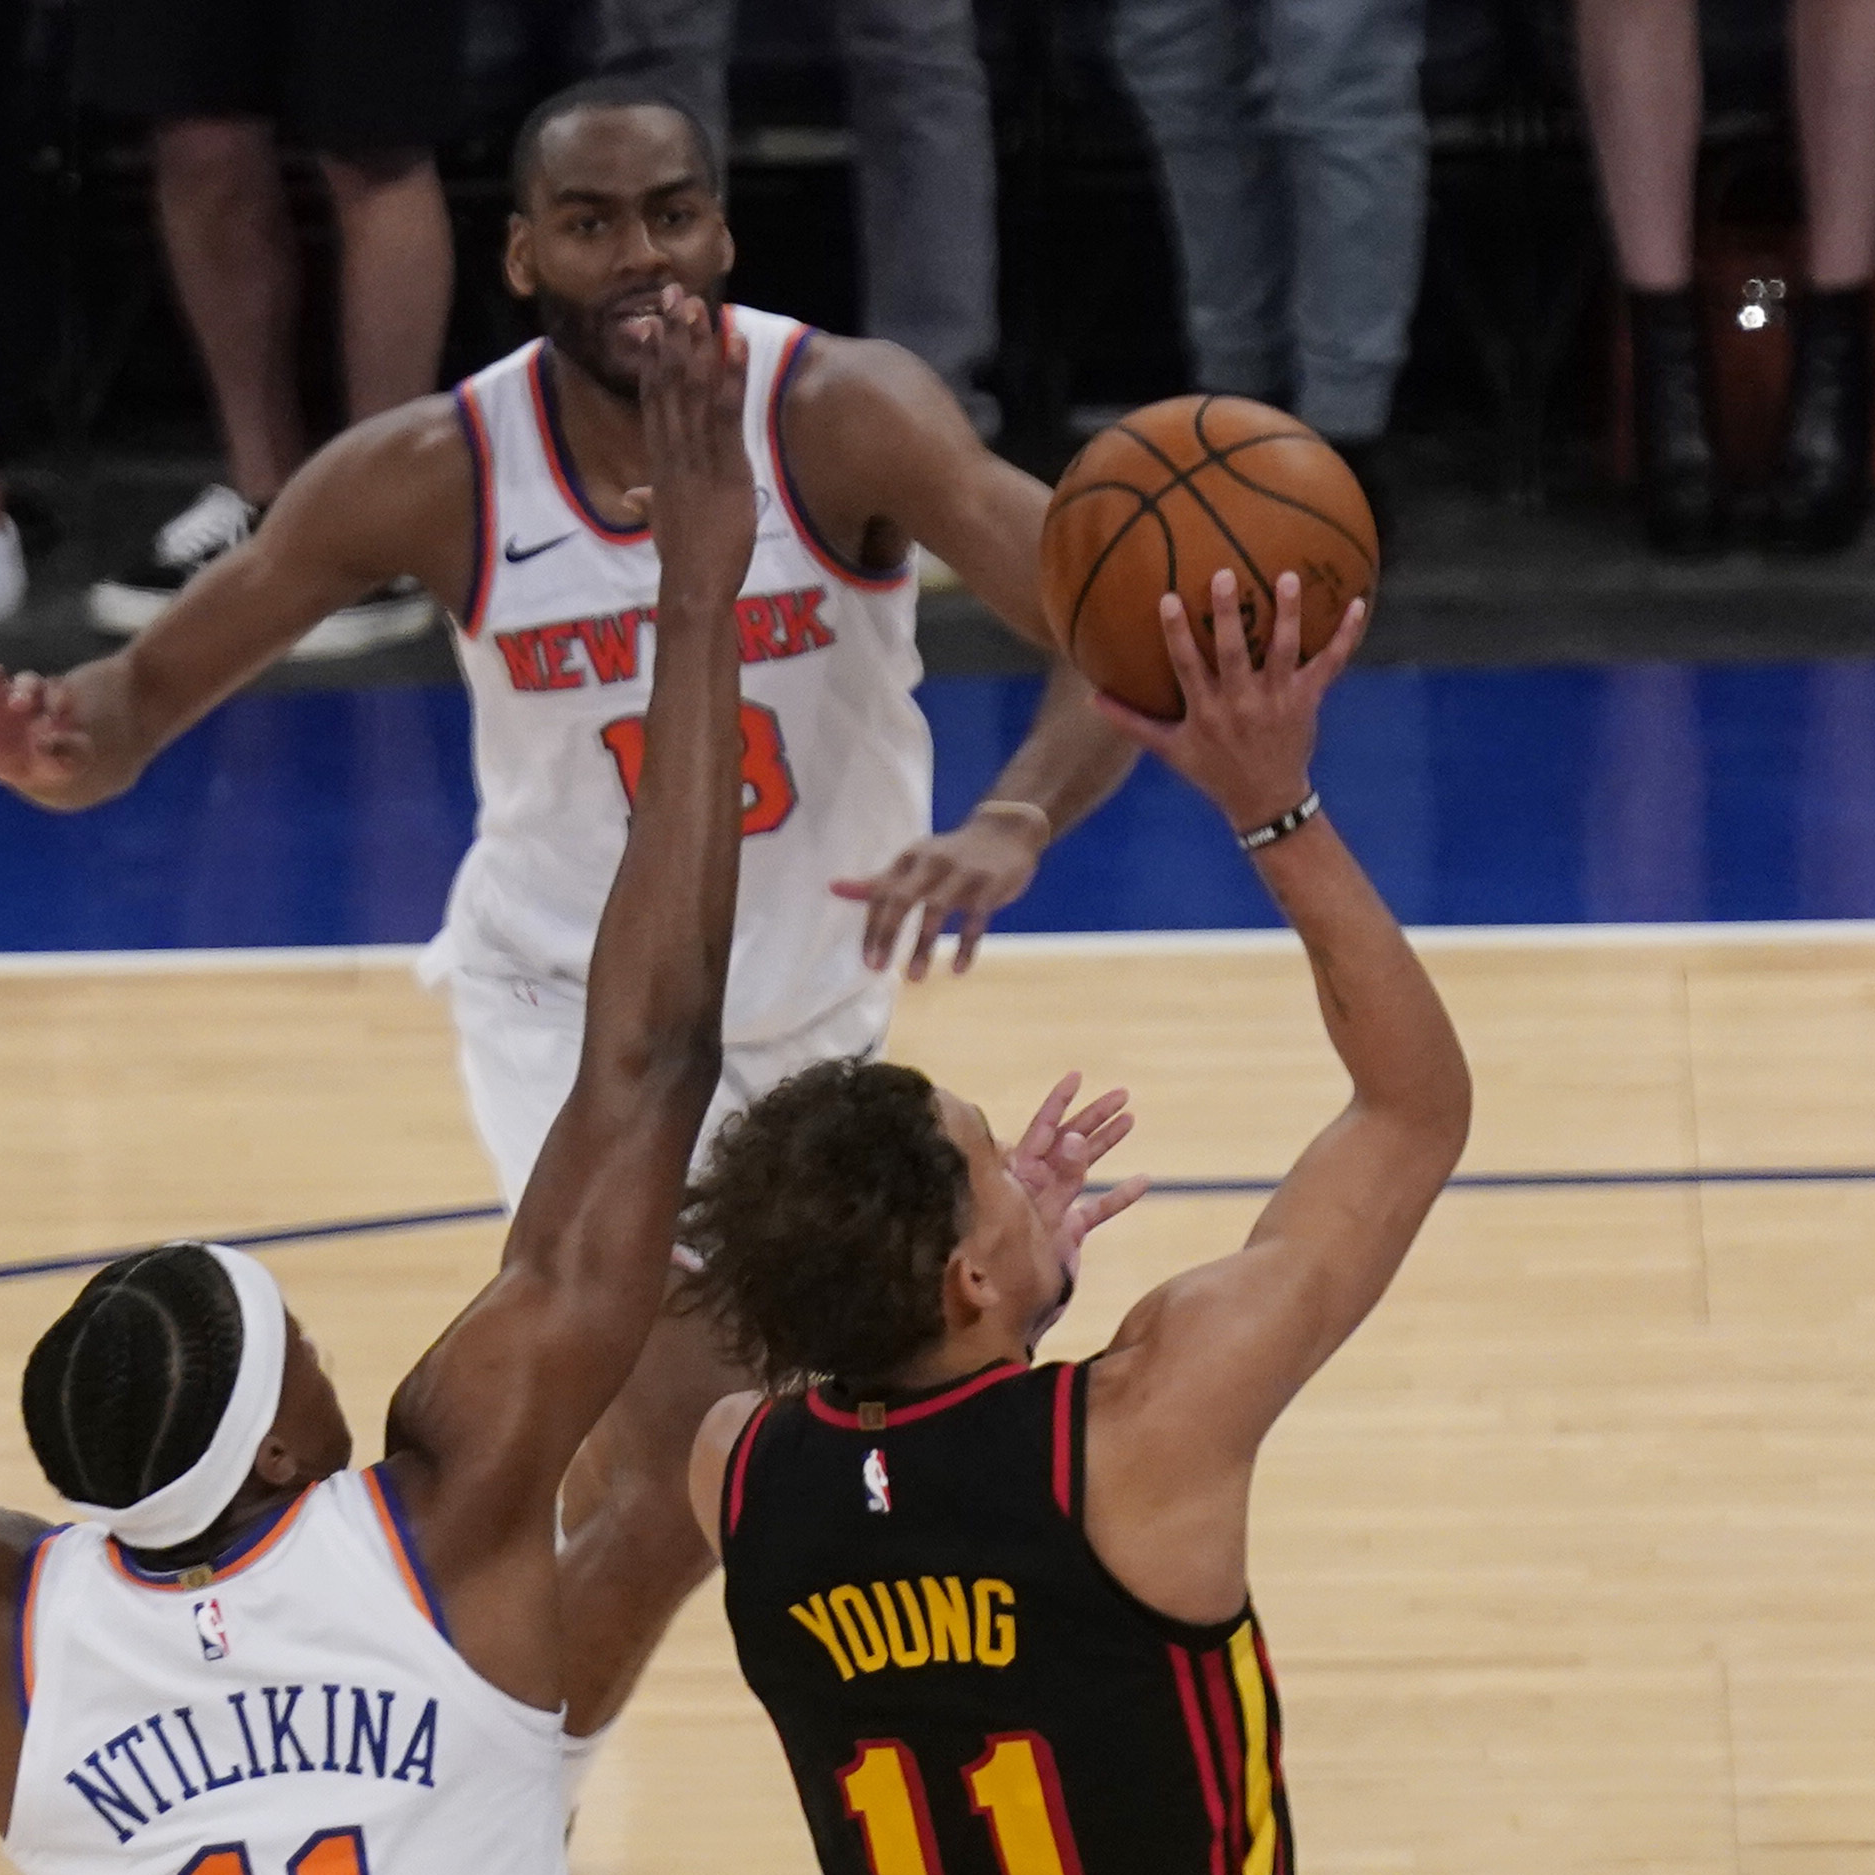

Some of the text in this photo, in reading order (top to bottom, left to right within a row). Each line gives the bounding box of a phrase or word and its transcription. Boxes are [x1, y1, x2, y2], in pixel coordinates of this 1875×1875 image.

[494, 613, 639, 692] NEW
[788, 1575, 1017, 1682] YOUNG
[65, 1683, 442, 1845] NTILIKINA
